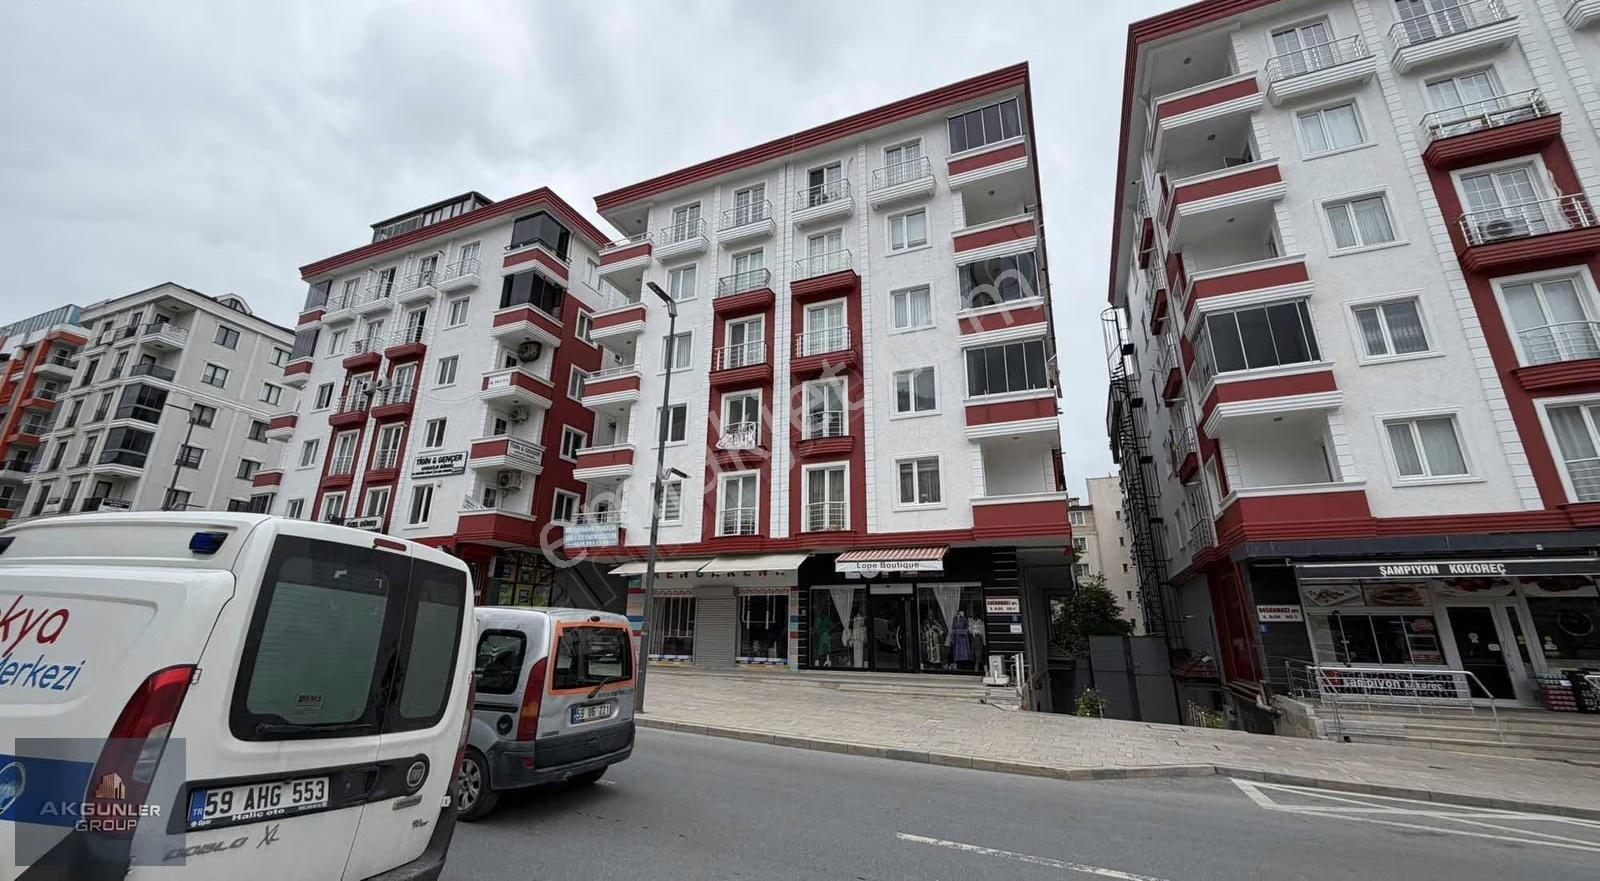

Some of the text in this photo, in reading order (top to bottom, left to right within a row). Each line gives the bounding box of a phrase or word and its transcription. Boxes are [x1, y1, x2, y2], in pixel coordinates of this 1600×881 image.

[856, 561, 920, 570] Lope Boutique
[1448, 563, 1507, 576] KOKOREÇ
[0, 594, 69, 658] kya
[193, 780, 325, 816] TR 59 AHG 553
[266, 808, 285, 816] oto
[256, 824, 281, 849] XL
